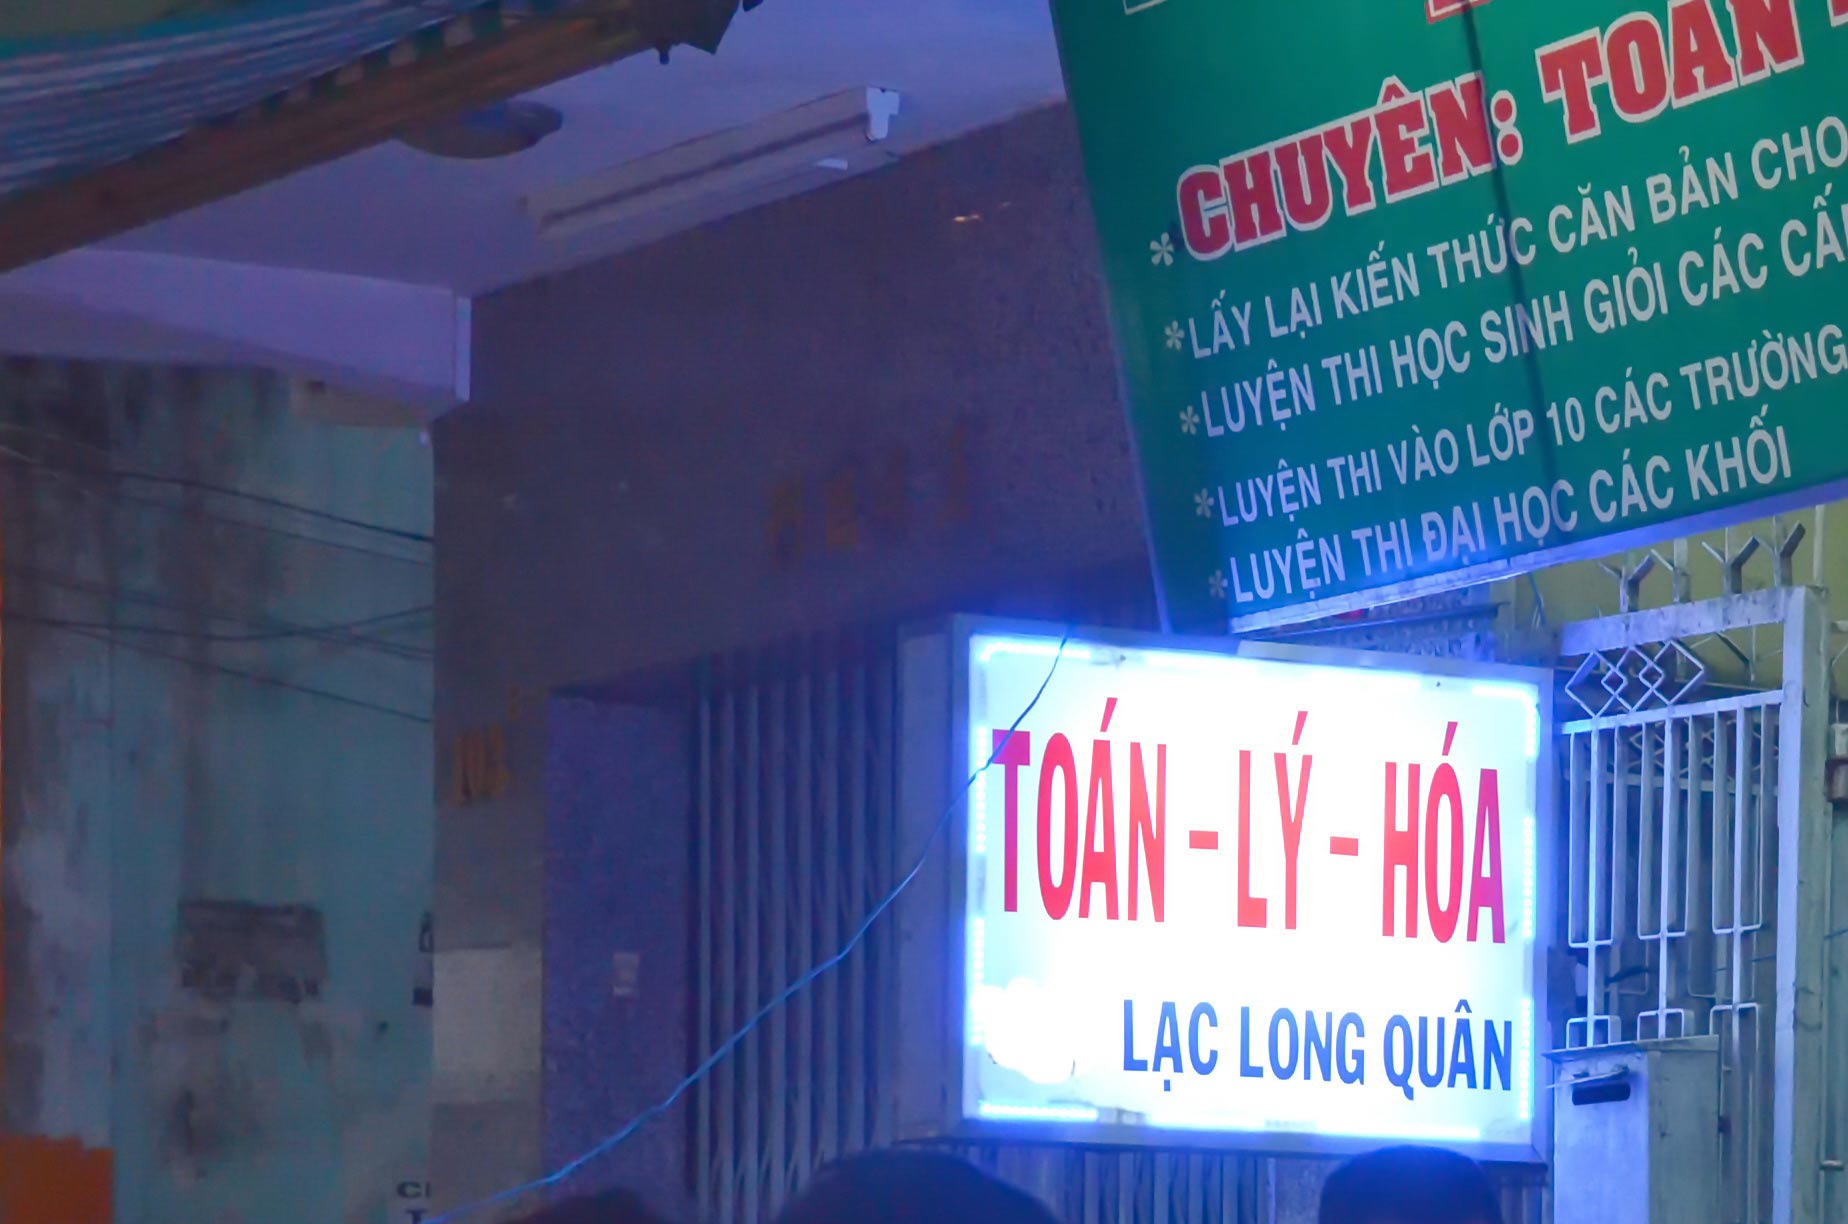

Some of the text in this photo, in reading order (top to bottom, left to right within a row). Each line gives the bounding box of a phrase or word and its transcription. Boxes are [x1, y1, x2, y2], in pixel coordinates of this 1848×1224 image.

[1177, 70, 1523, 261] CHUYÊN:
[1186, 290, 1254, 360] LẤY
[1265, 280, 1322, 339] LẠI
[1332, 242, 1421, 321] KIẾN
[1427, 214, 1537, 294] THỨC
[1549, 182, 1637, 254] CĂN
[1646, 146, 1740, 226] BẢN
[1201, 358, 1317, 438] LUYỆN
[1322, 345, 1384, 413] THI
[1389, 321, 1471, 391] HỌC
[1480, 289, 1574, 366] SINH
[1583, 247, 1670, 336] GIỎI
[1678, 228, 1769, 307] CÁC
[1218, 458, 1322, 527] LUYỆN
[1327, 449, 1382, 500] THI
[1388, 424, 1459, 485] VÀO
[1467, 402, 1534, 467] LỚP
[1546, 400, 1586, 446] 10
[1595, 367, 1673, 433] CÁC
[1680, 323, 1848, 409] TRƯỜNG
[1230, 404, 1791, 602] LUYỆN THI ĐẠI HỌC CÁC KHỐI
[992, 697, 1166, 923] TOÁN
[1237, 710, 1312, 930] LÝ
[1382, 721, 1506, 944] HÓA
[1123, 1000, 1512, 1101] LẠC LONG QUÂN
